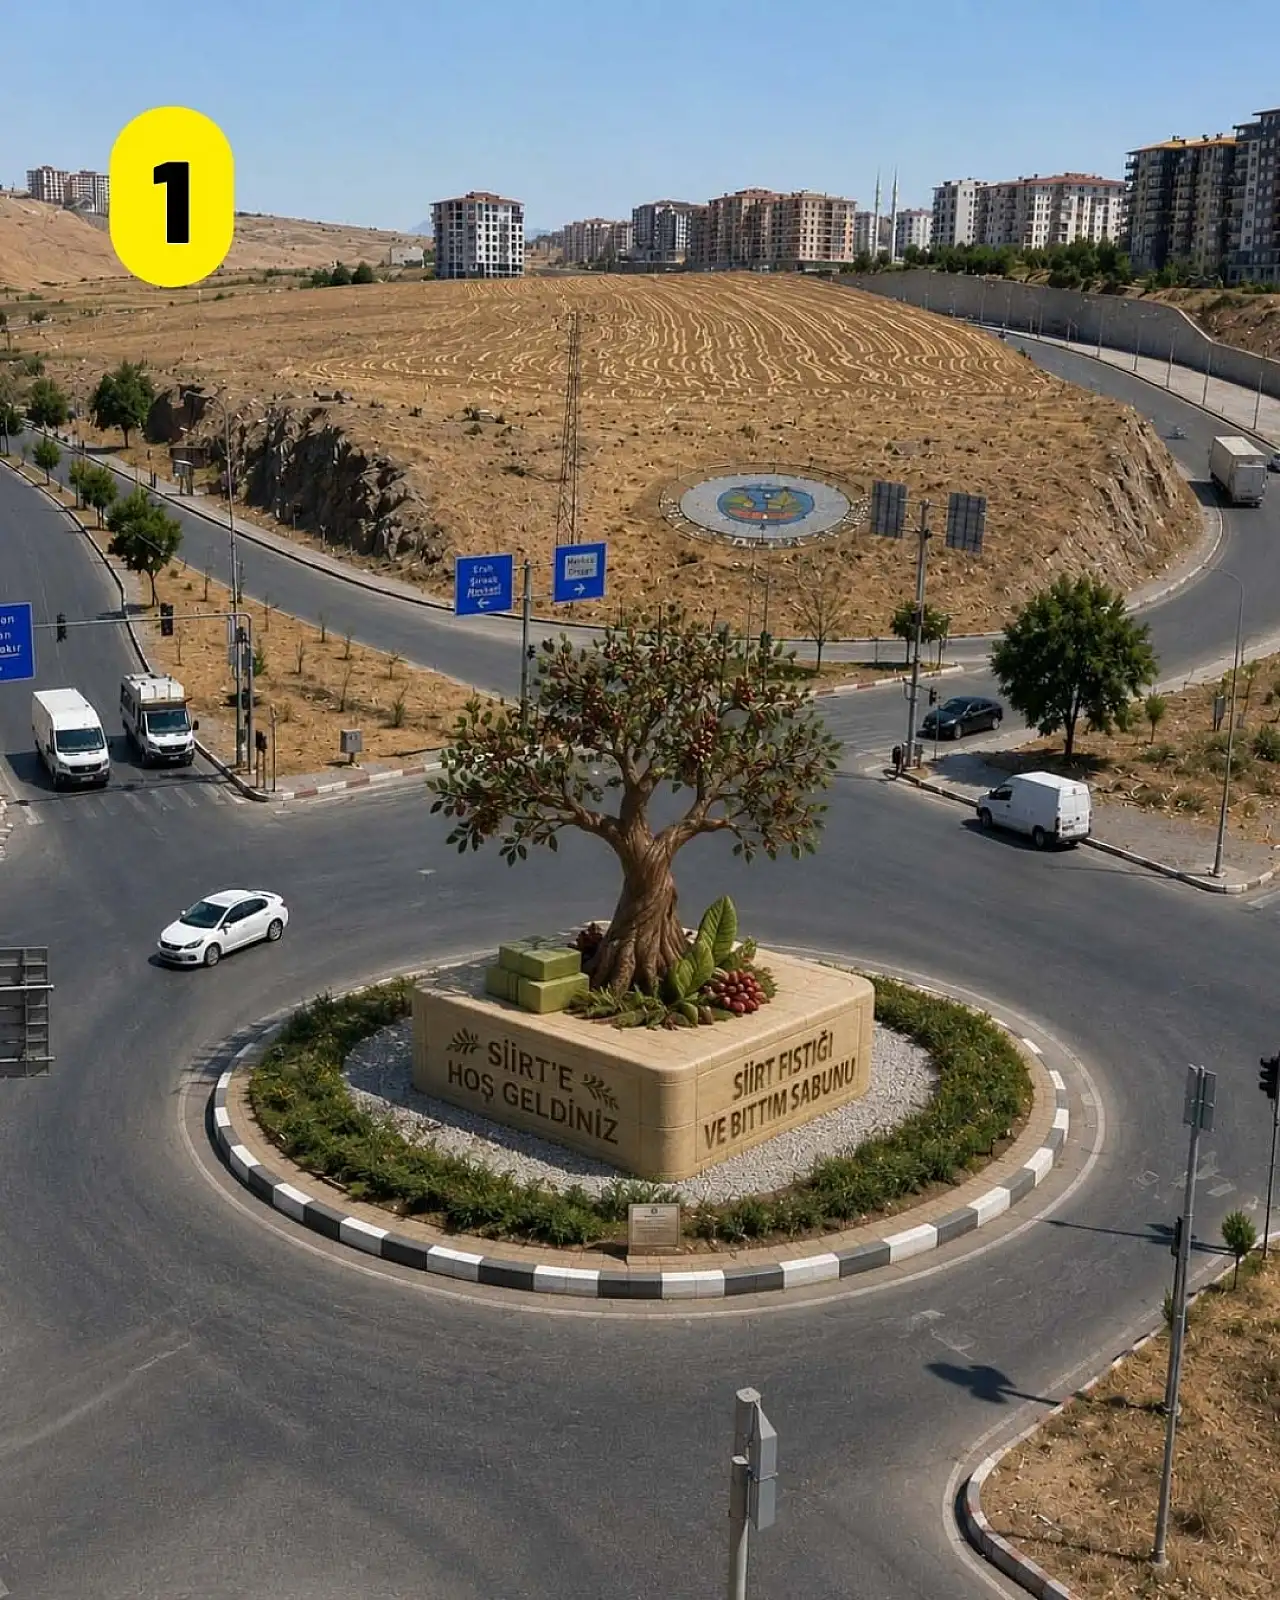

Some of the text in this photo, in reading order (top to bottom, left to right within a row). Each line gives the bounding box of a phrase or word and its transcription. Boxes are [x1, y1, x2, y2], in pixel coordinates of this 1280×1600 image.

[447, 1060, 619, 1146] HOŞ GELDİNİZ
[487, 1038, 573, 1093] SİİRT'E
[704, 1057, 856, 1150] VE BITTIM SABUNU
[732, 1029, 834, 1101] SİİRT FISTIĞI
